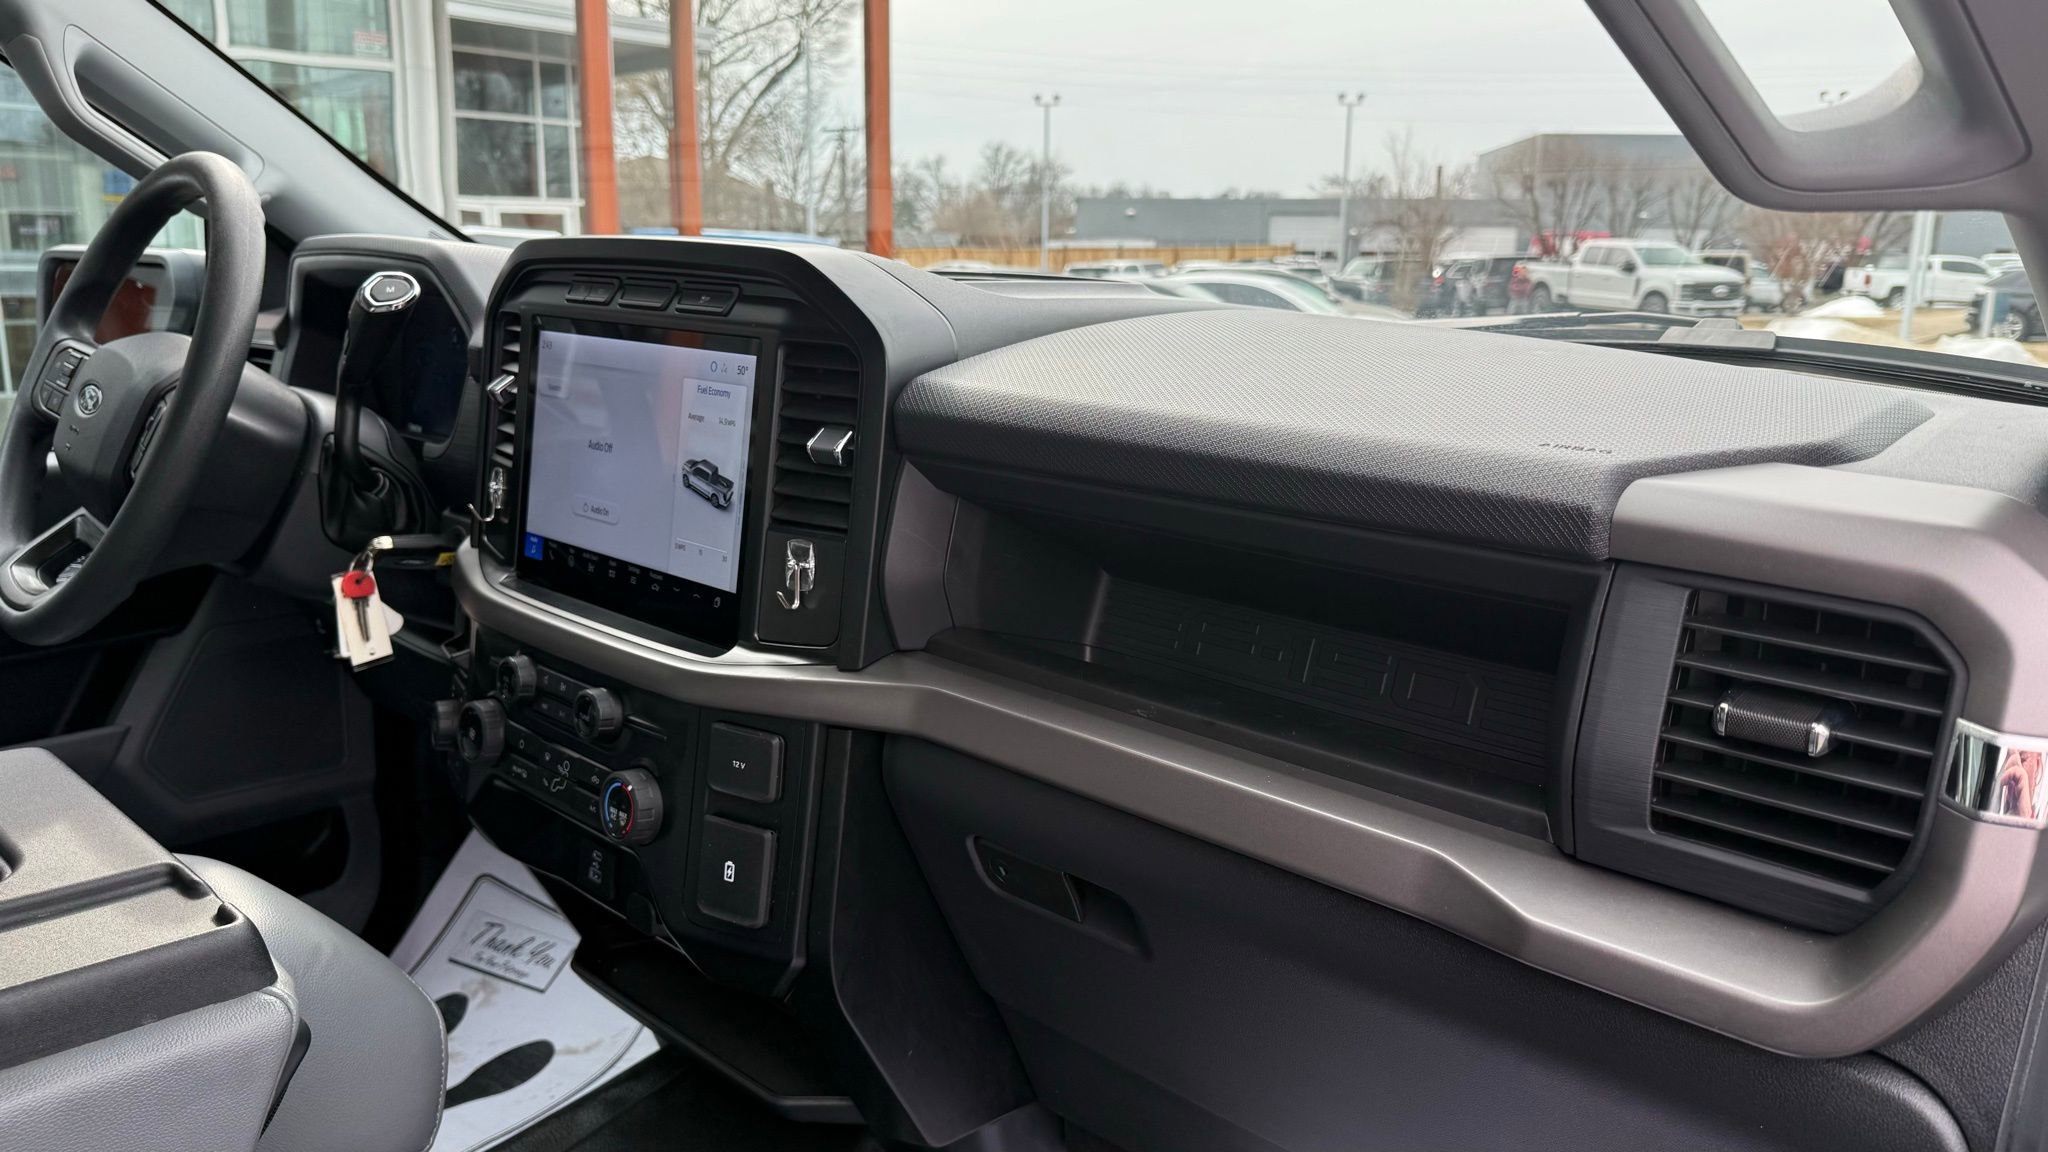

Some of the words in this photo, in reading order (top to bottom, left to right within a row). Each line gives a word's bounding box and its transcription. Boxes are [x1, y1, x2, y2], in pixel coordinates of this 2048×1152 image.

[386, 286, 395, 294] M
[697, 385, 708, 395] Fuel
[708, 386, 731, 399] Economy
[588, 439, 604, 452] Audio
[604, 442, 614, 454] Off
[732, 760, 740, 769] 12
[470, 921, 537, 957] Thank
[526, 940, 561, 969] You
